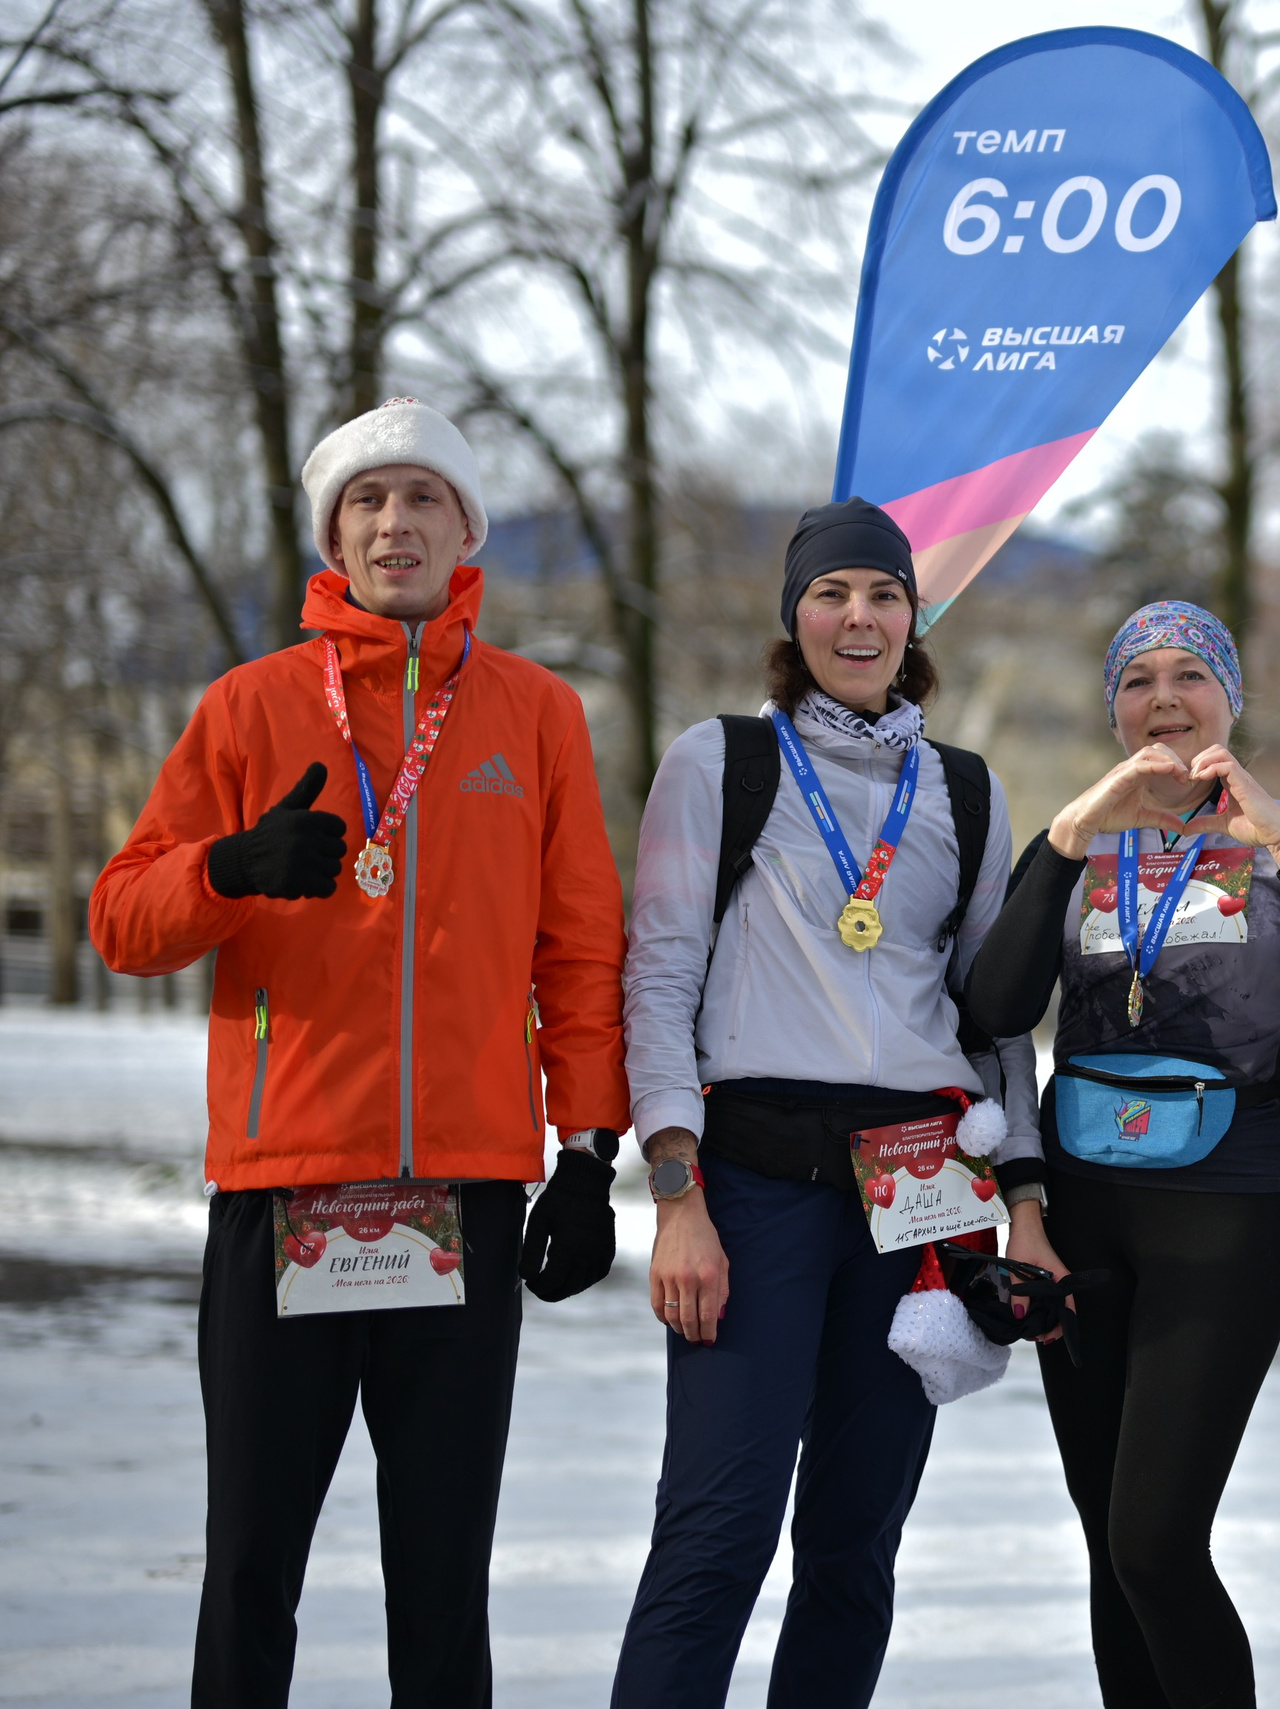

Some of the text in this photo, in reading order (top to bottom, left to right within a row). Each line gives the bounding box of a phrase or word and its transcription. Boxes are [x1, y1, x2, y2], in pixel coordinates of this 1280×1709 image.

[942, 174, 1182, 257] 6:00
[981, 324, 1126, 347] ВЫСШАЯ
[972, 351, 1057, 372] ЛИГА
[780, 725, 803, 767] ВЫСШАЯ ЛИГА
[393, 767, 418, 809] 2026
[459, 775, 525, 798] adidas
[837, 850, 850, 870] ЛИГА
[1194, 860, 1220, 871] абег
[1102, 893, 1116, 904] 78
[1150, 913, 1166, 945] ВЫСШАЯ
[1163, 896, 1174, 913] ЛИГА
[1165, 920, 1226, 944] обежал!
[879, 1135, 940, 1159] Новогодний
[873, 1184, 888, 1198] 110
[899, 1189, 942, 1215] ДАША
[310, 1194, 426, 1219] Новогодний забег
[329, 1249, 411, 1274] ЕВГЕНИЙ
